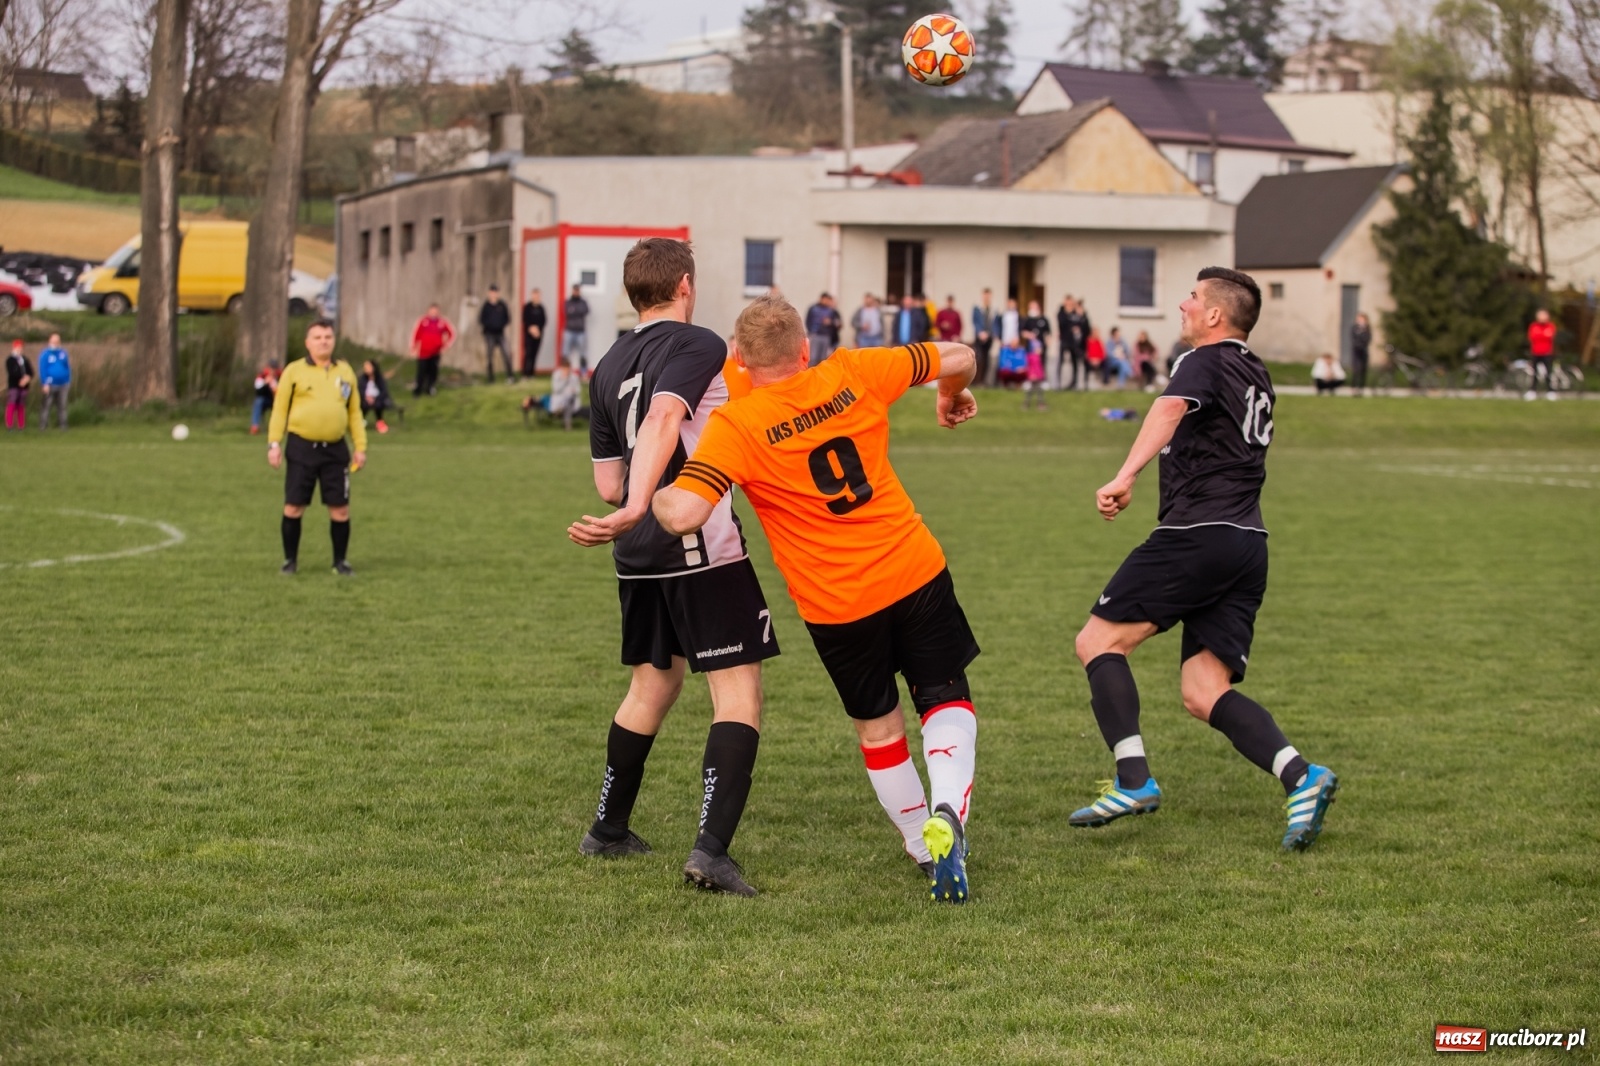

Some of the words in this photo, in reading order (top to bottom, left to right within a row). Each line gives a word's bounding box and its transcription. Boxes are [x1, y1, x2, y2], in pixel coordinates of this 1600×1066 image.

[617, 372, 643, 450] 7
[765, 421, 794, 446] LKS
[792, 386, 858, 434] BOJANÓW
[1242, 384, 1274, 447] 10
[808, 435, 874, 516] 9
[758, 608, 771, 644] 7
